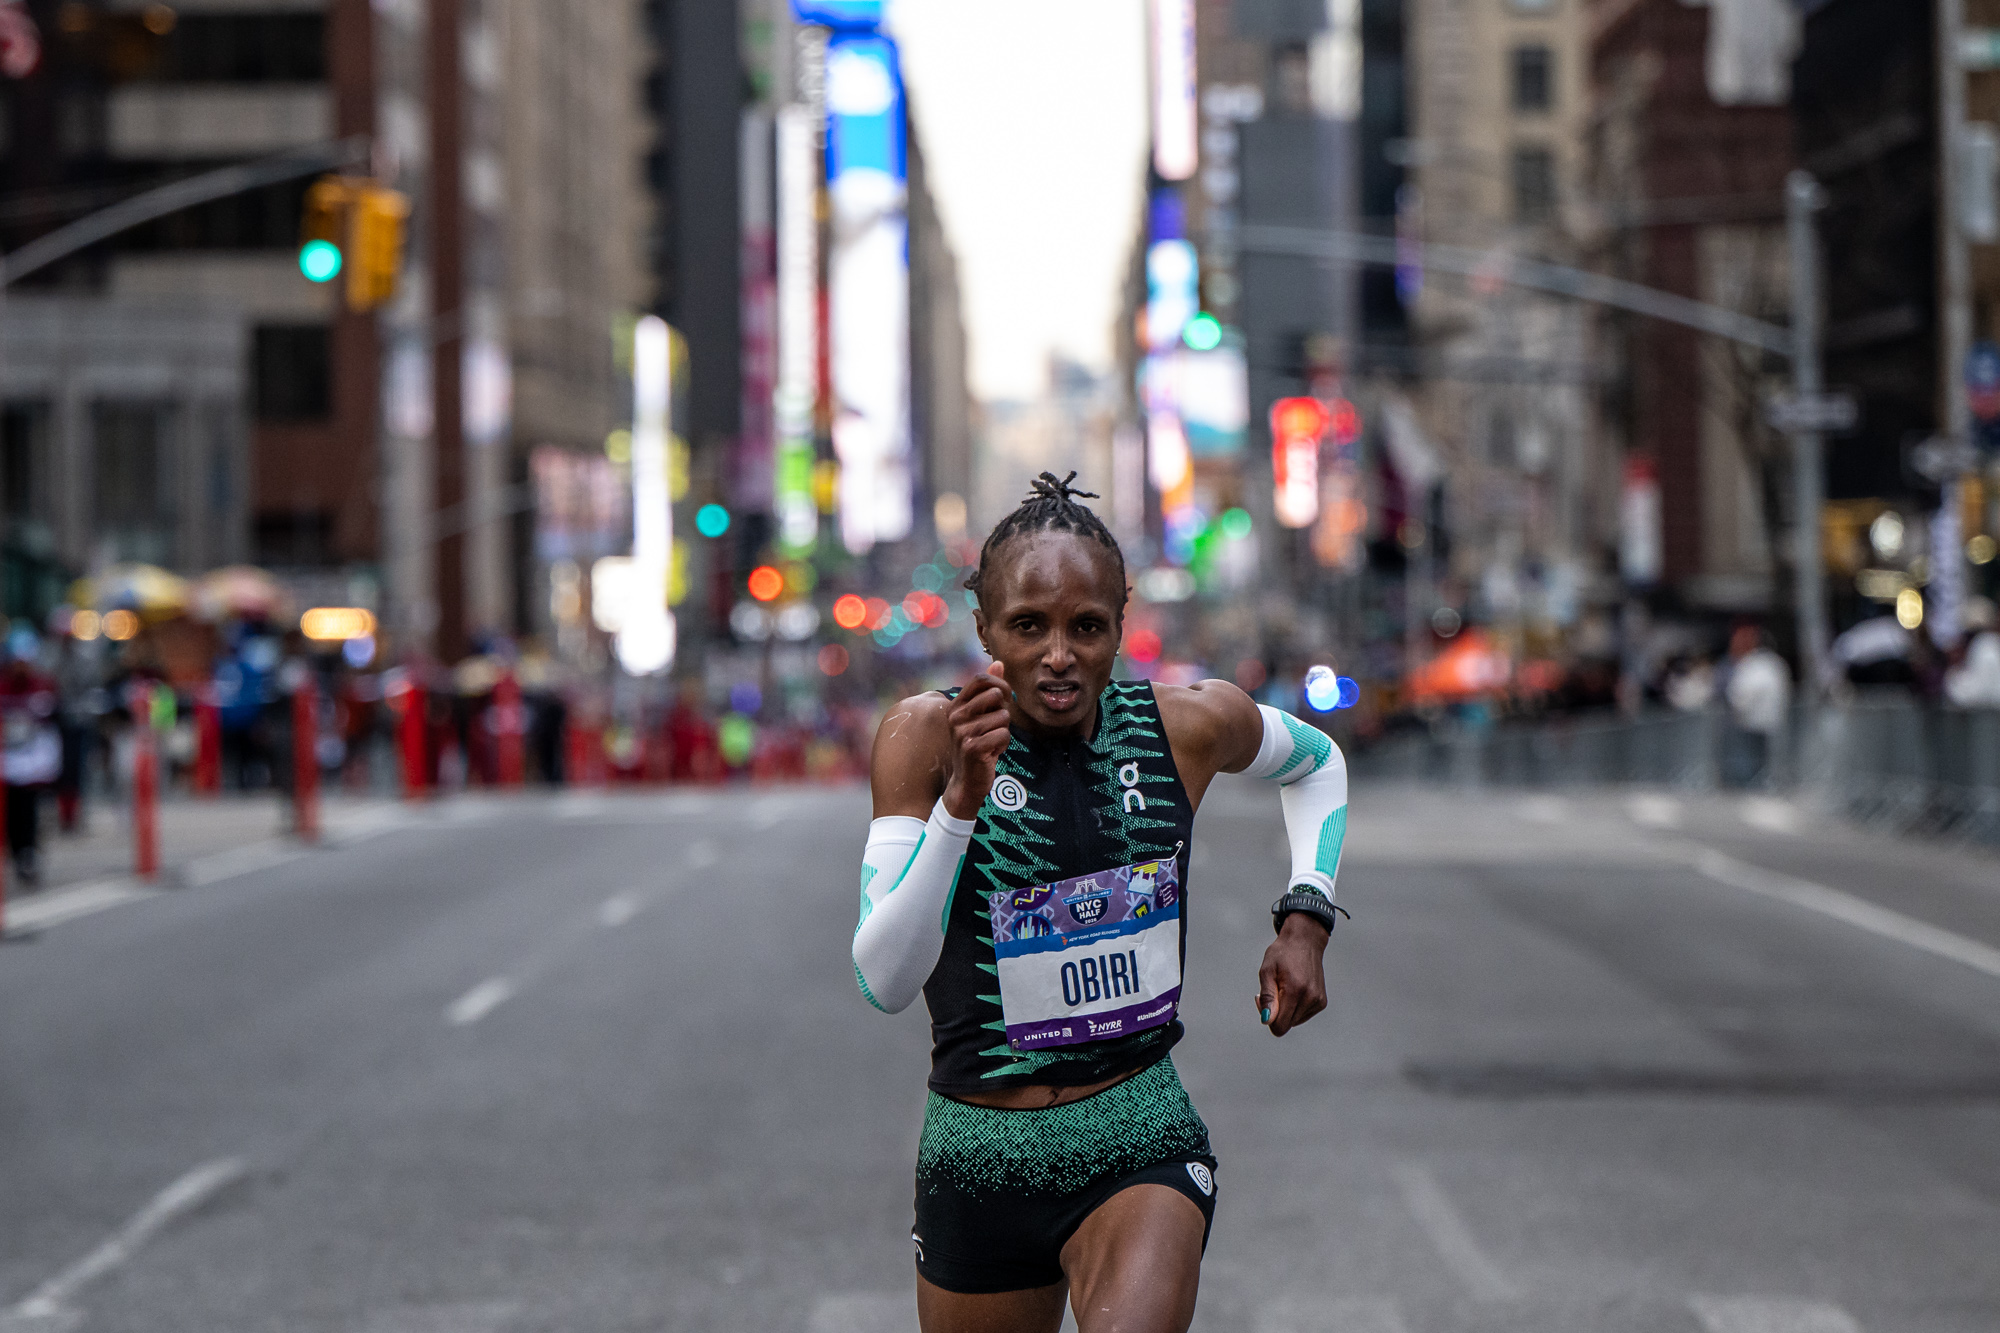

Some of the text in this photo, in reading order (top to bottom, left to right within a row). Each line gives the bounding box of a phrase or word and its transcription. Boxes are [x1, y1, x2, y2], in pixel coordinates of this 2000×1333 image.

[1075, 898, 1102, 913] NYC
[1079, 908, 1101, 919] HALF
[1101, 928, 1121, 936] RUNNERS
[1060, 950, 1140, 1007] OBIRI
[1098, 1019, 1122, 1032] NYRR
[1024, 1030, 1061, 1041] UNITED
